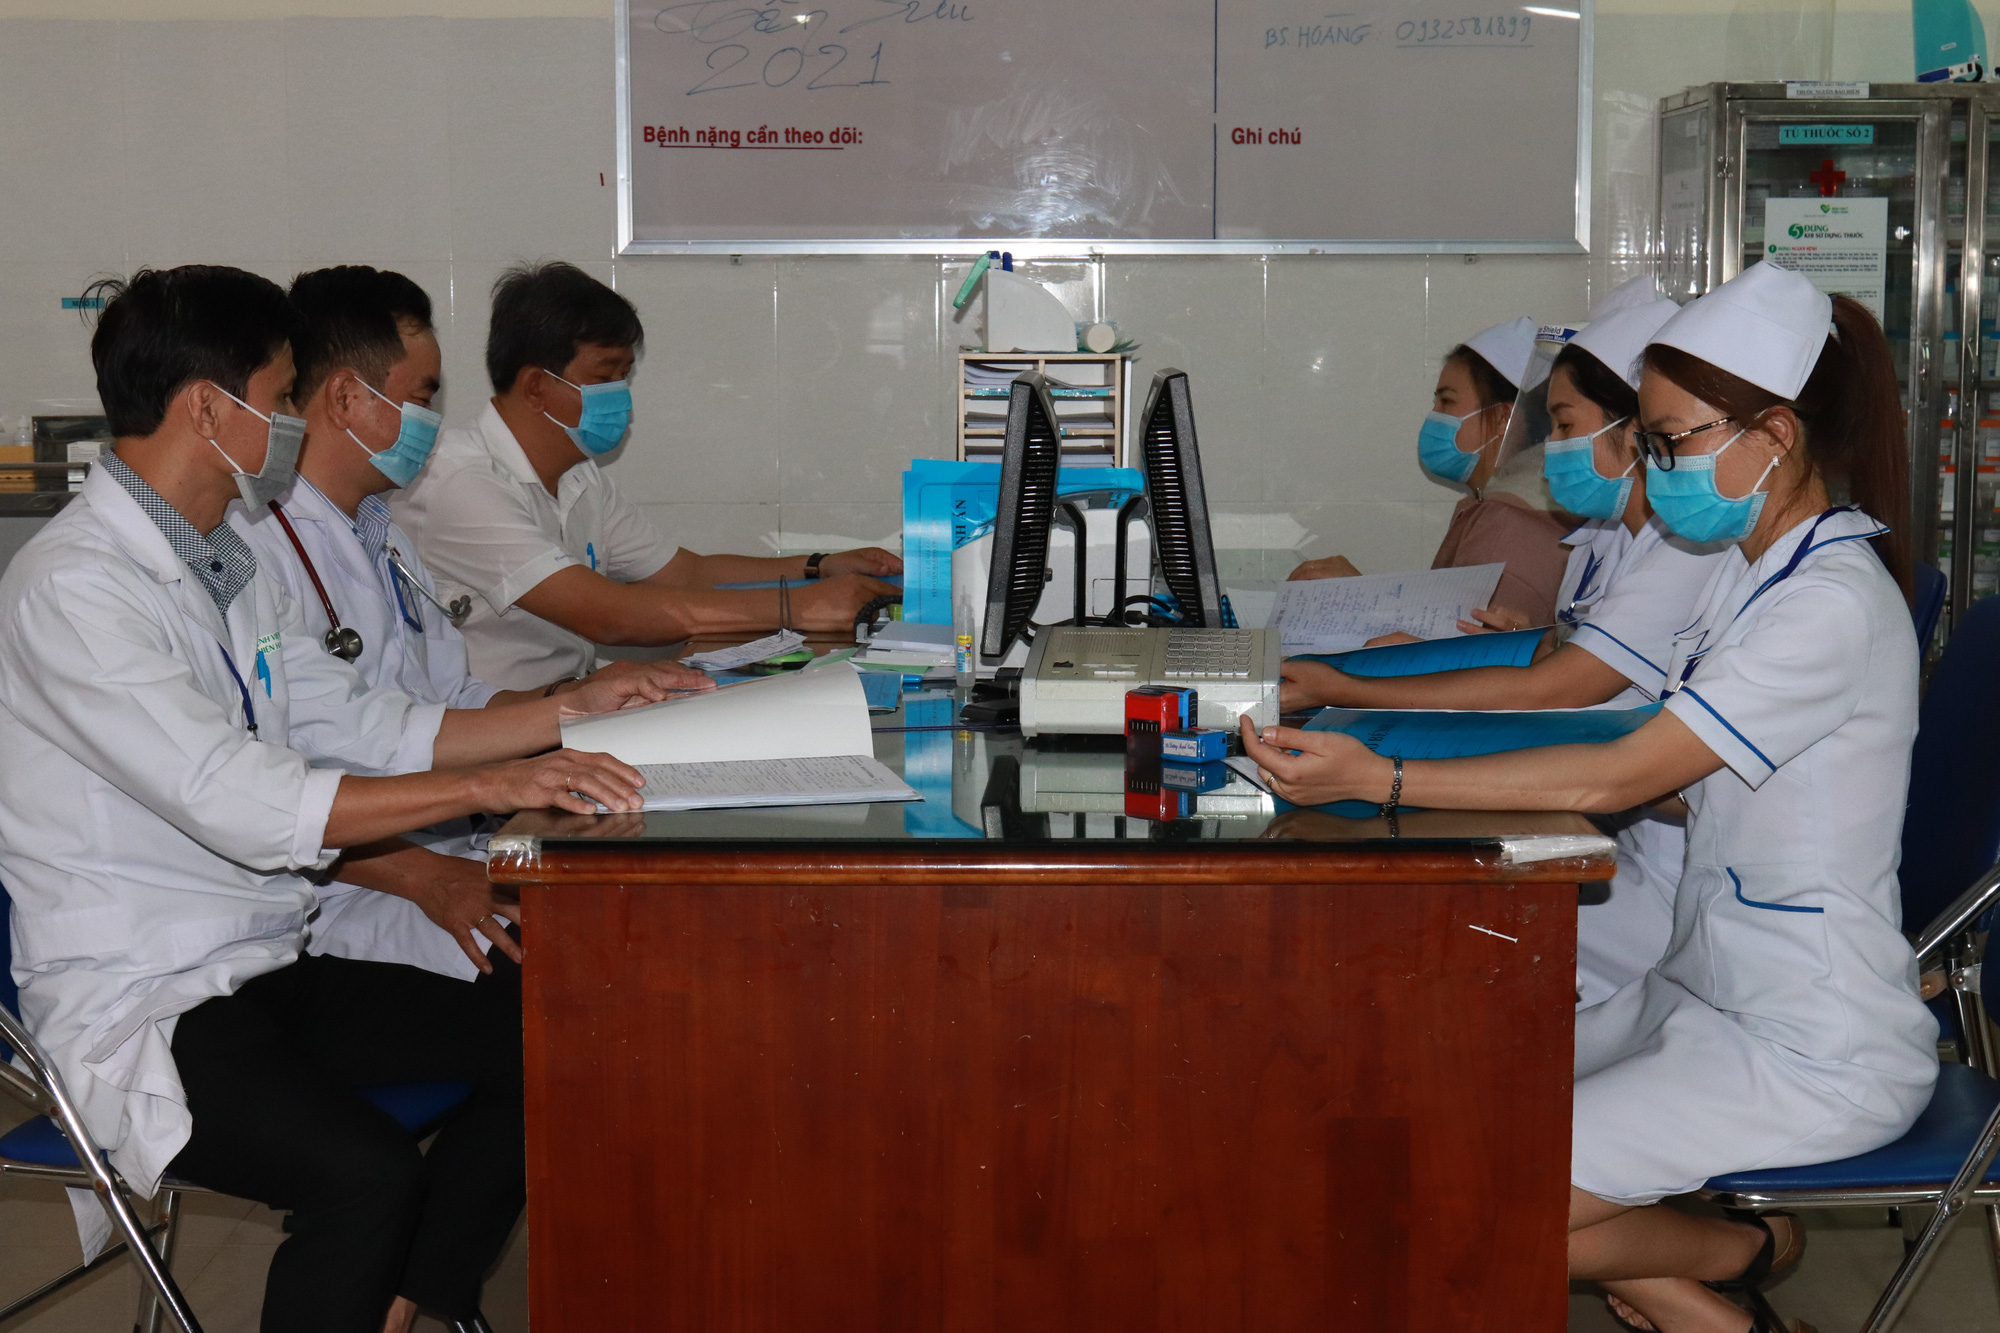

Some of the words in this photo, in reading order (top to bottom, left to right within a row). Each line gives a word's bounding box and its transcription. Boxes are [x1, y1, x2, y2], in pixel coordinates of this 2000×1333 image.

[686, 42, 891, 96] 2021
[643, 125, 690, 146] Bệnh
[696, 126, 741, 148] nặng
[747, 124, 779, 144] cần
[785, 126, 824, 144] theo
[829, 126, 864, 144] dõi:
[1231, 127, 1262, 145] Ghi
[1268, 126, 1302, 145] chú
[1803, 126, 1844, 138] THUỐC
[1846, 126, 1862, 138] SỐ
[1864, 128, 1870, 138] 2
